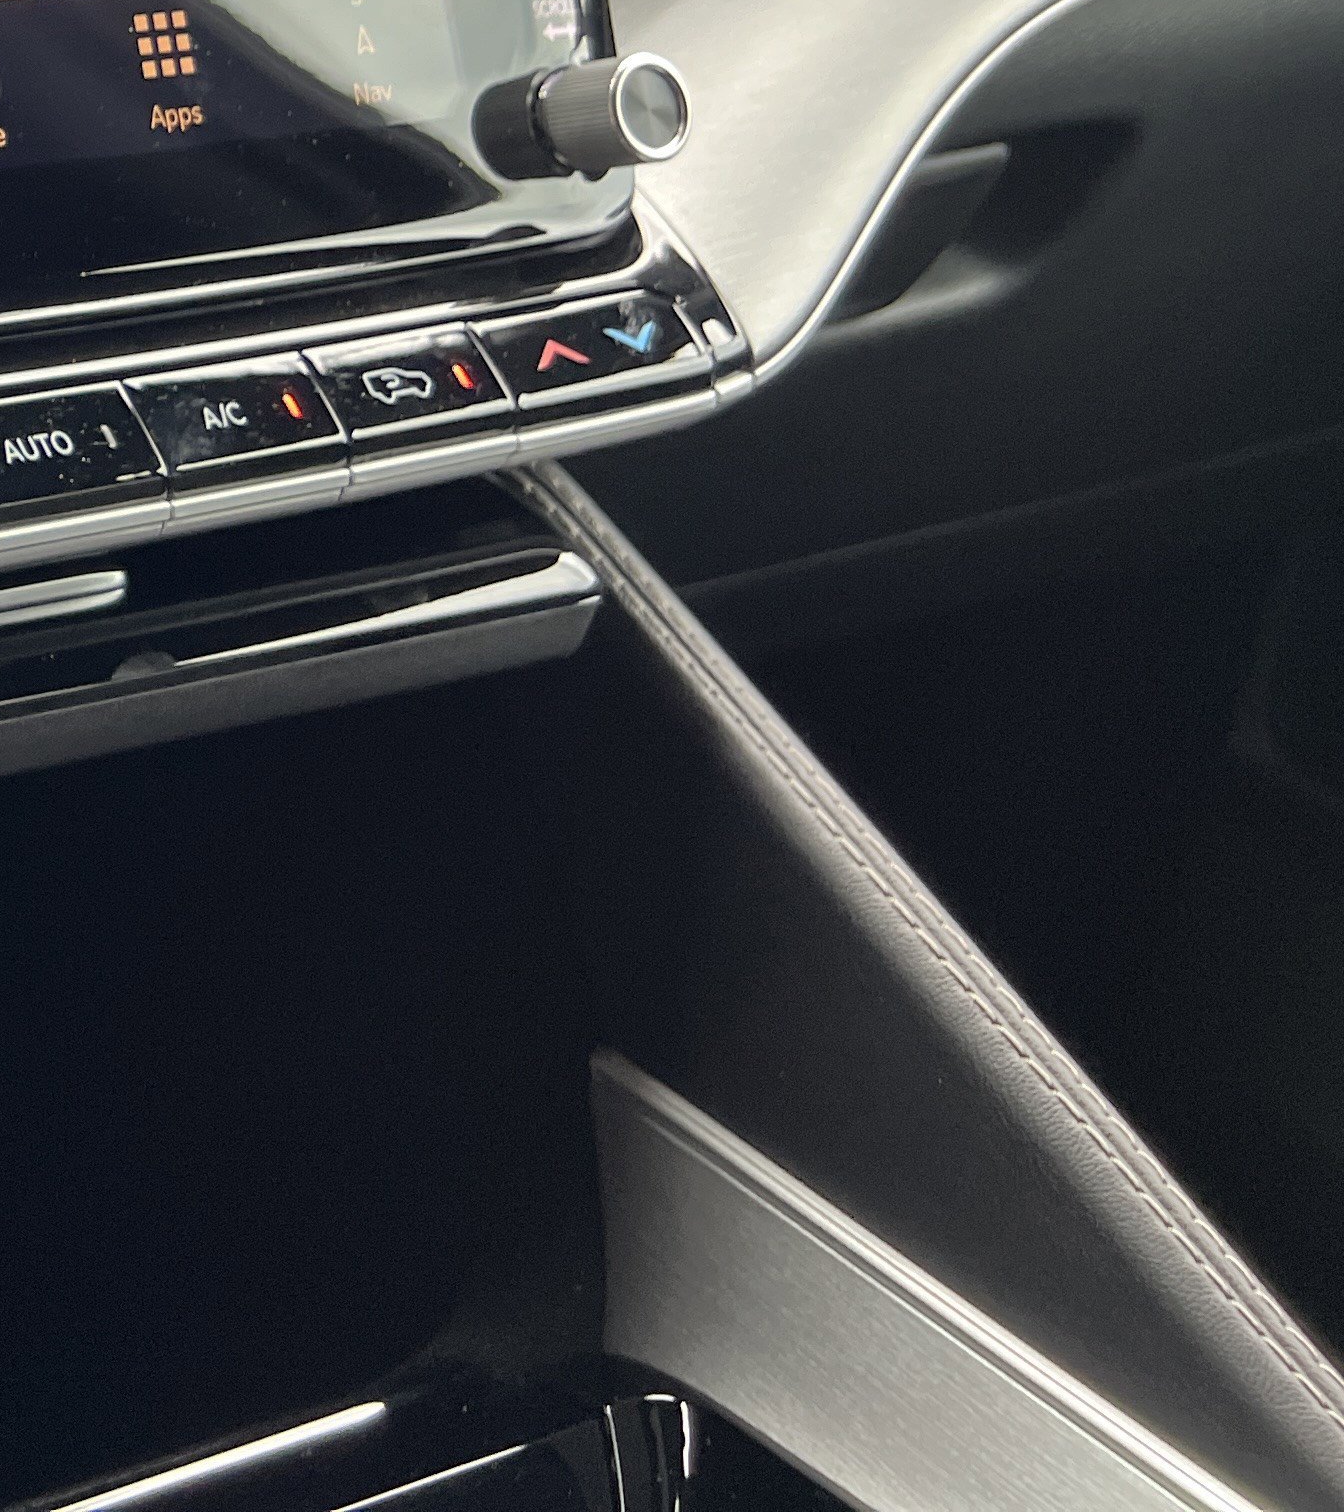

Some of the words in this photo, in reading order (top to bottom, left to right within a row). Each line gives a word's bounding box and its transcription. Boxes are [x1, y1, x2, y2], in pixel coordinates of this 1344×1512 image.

[352, 81, 393, 107] Nav
[149, 102, 205, 135] Apps
[201, 400, 249, 433] A/C
[3, 429, 74, 465] AUTO
